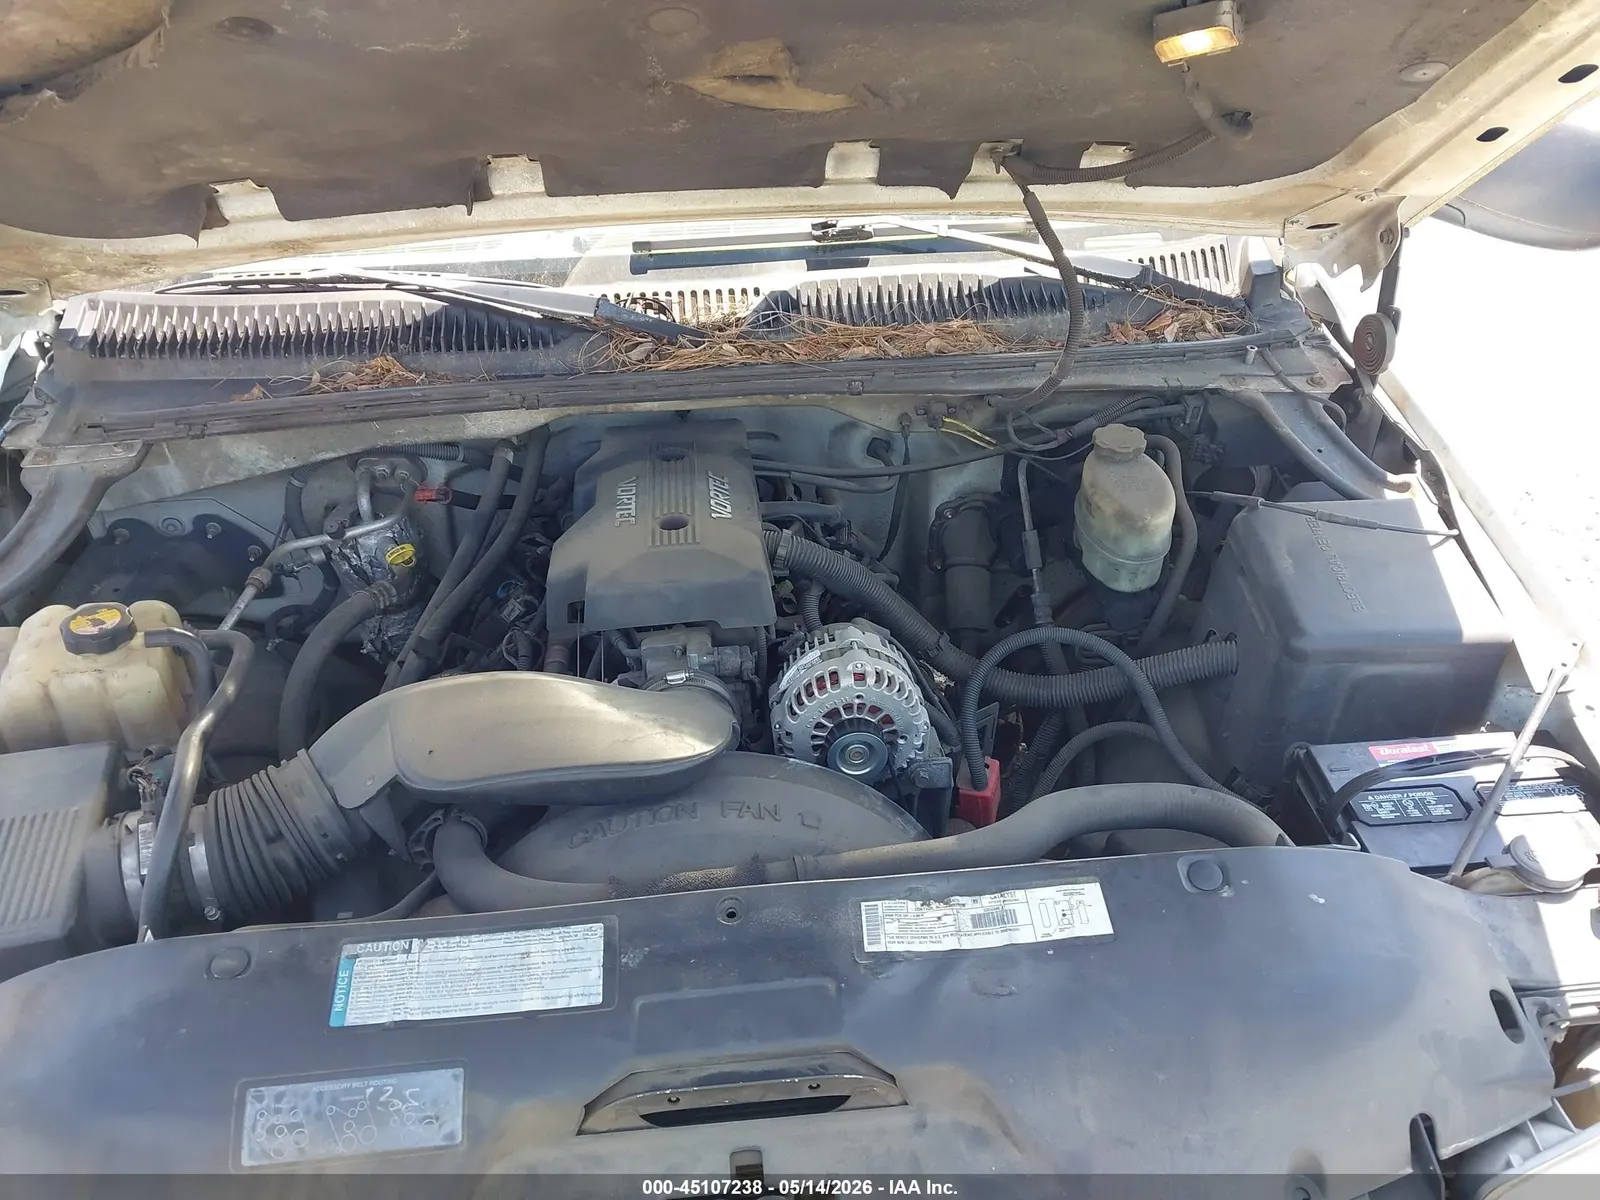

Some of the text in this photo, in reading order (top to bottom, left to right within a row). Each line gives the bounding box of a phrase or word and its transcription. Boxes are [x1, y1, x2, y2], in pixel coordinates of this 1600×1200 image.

[615, 476, 637, 527] VORTEC
[708, 470, 733, 520] VORTEC
[1380, 743, 1430, 756] Duralast
[568, 800, 782, 850] CAUTION FAN
[356, 941, 410, 953] CAUTION
[334, 969, 349, 1012] NOTICE
